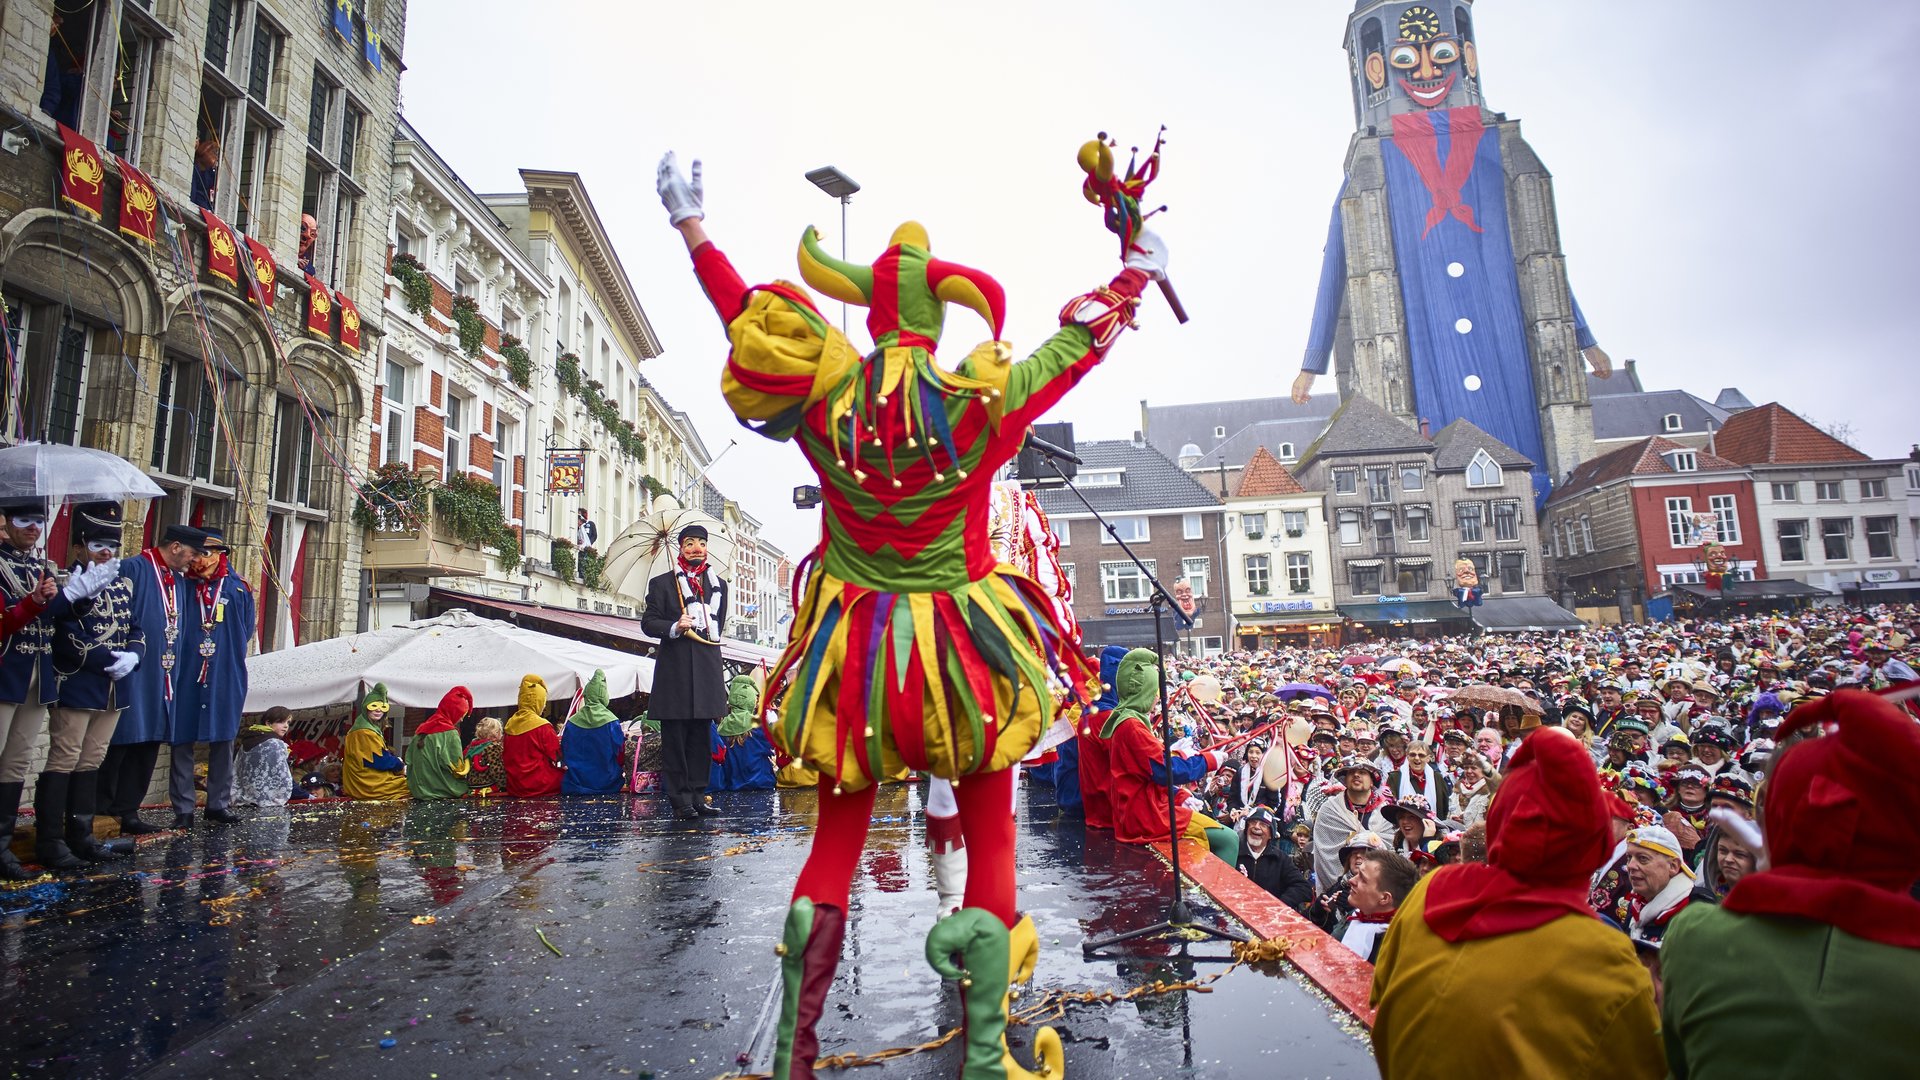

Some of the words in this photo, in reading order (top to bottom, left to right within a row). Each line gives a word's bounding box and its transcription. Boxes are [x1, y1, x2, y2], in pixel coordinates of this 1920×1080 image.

[1105, 605, 1145, 615] Bavaria
[1265, 600, 1313, 612] Bavaria
[1668, 667, 1682, 677] 11
